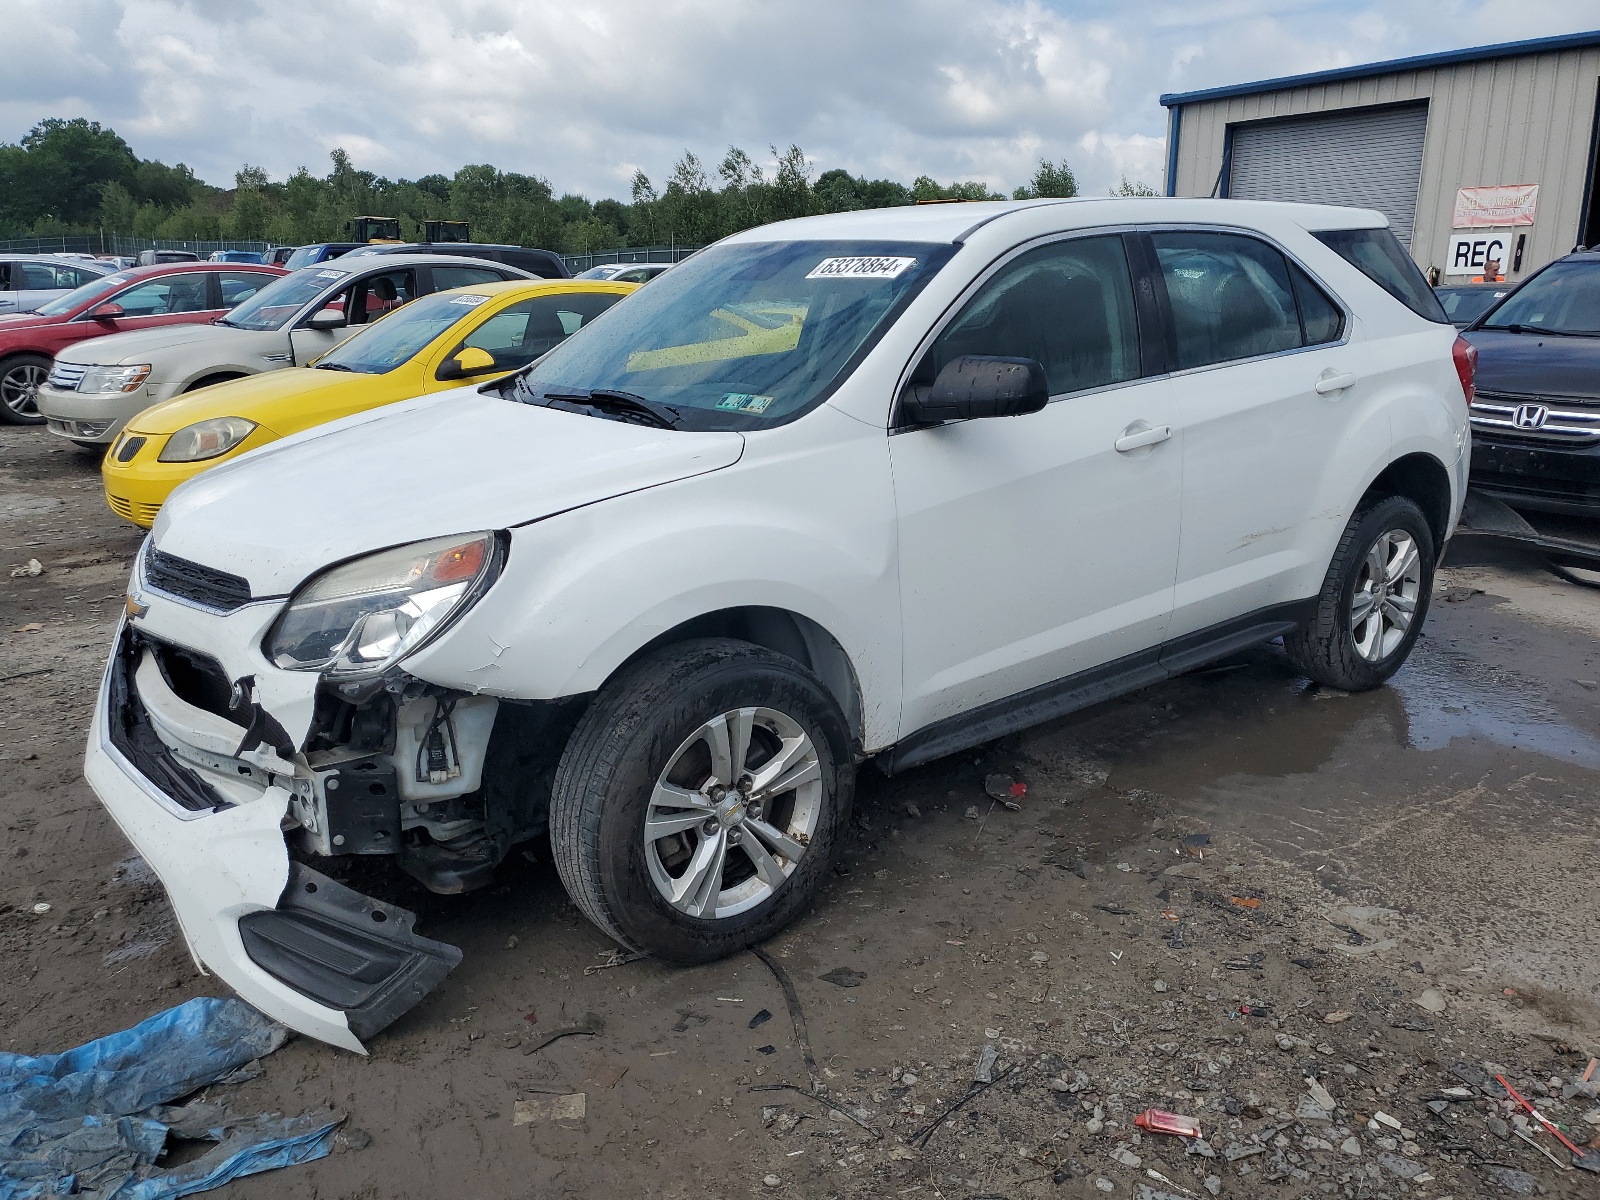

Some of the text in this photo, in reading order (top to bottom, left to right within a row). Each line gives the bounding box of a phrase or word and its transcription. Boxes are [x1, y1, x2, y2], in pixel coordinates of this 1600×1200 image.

[1486, 196, 1511, 207] COMES
[1512, 194, 1533, 206] FIRST
[1454, 240, 1503, 267] REC
[820, 257, 899, 273] 63378864
